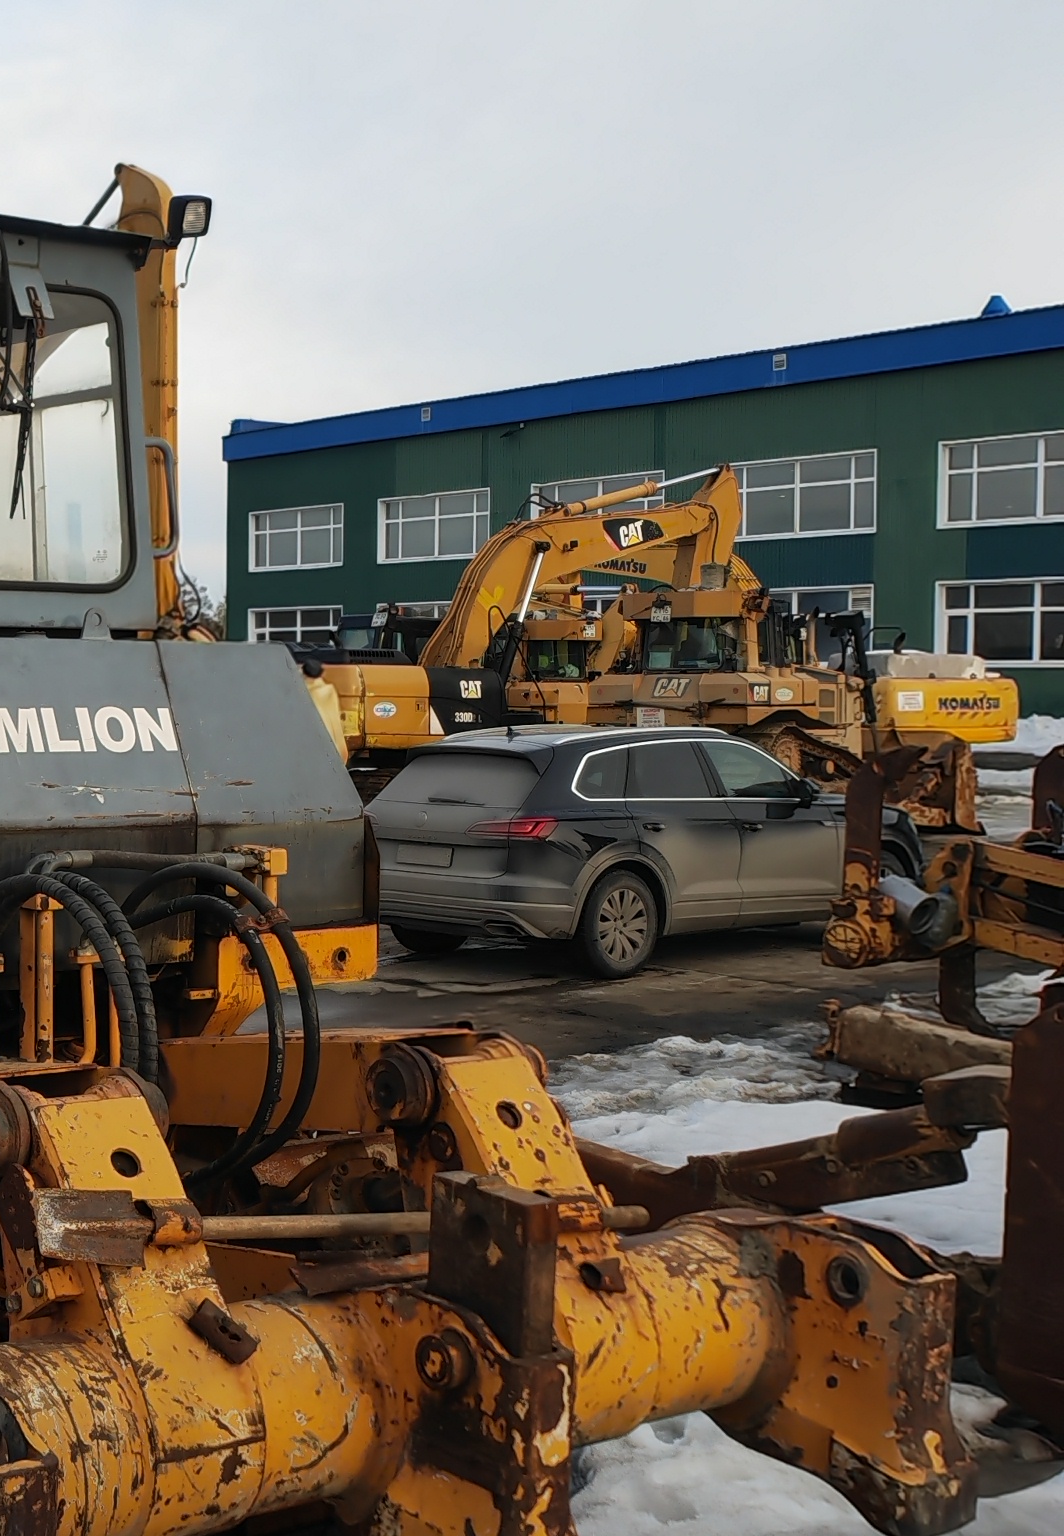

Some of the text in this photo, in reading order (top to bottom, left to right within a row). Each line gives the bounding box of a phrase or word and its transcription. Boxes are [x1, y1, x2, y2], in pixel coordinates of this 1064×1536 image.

[619, 520, 644, 547] CAT
[459, 680, 482, 699] CAT
[653, 678, 690, 697] CAT
[753, 685, 769, 702] CAT
